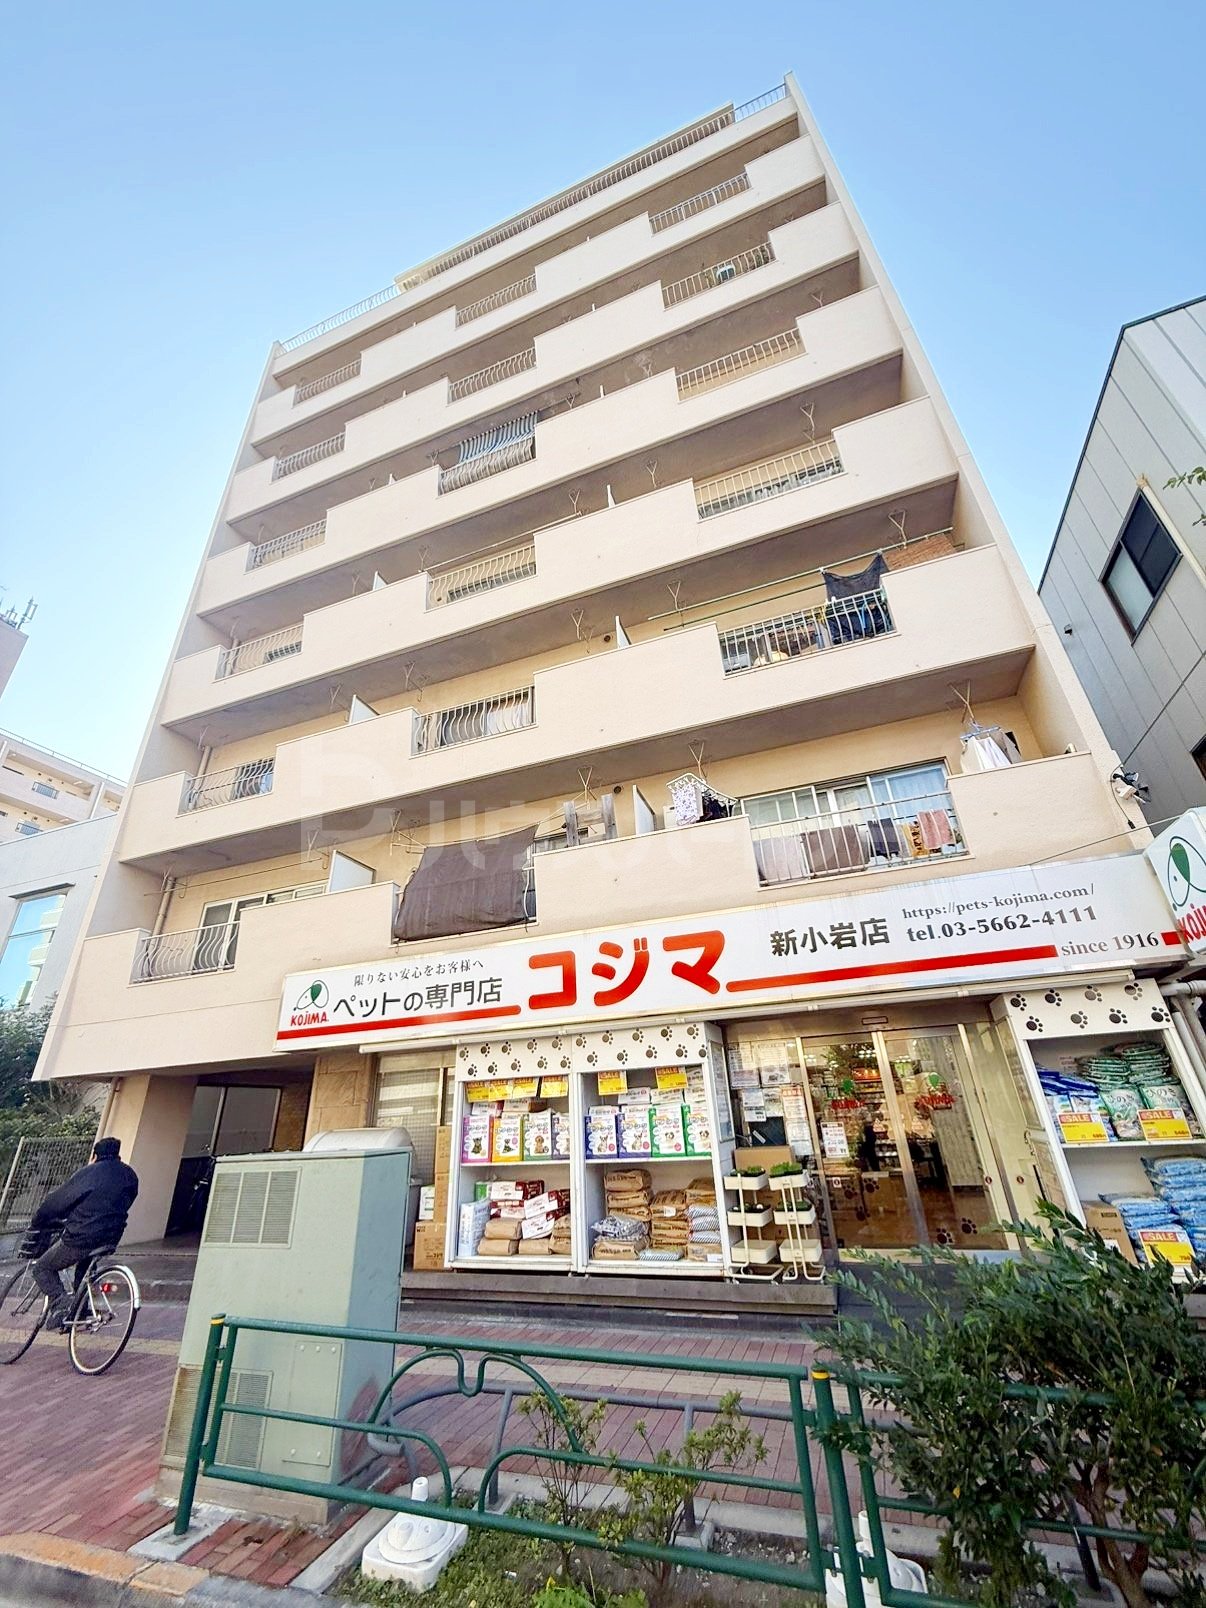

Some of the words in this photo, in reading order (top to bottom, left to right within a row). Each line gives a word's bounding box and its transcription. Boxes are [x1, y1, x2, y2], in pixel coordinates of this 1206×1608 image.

[902, 883, 1094, 919] https://pets-kojima.com/
[770, 918, 890, 957] 新小岩店
[906, 905, 1097, 942] tel.03-5662-4111
[1061, 940, 1108, 957] since
[1112, 931, 1159, 951] 1916
[354, 959, 484, 987] 限りない安心をお客様へ
[529, 930, 725, 1009] コジマ
[333, 977, 502, 1018] ペットの専門店
[290, 1011, 328, 1026] KOJIMA
[1065, 1114, 1090, 1122] SALE
[1146, 1110, 1172, 1119] SALE
[1149, 1232, 1174, 1241] SALE
